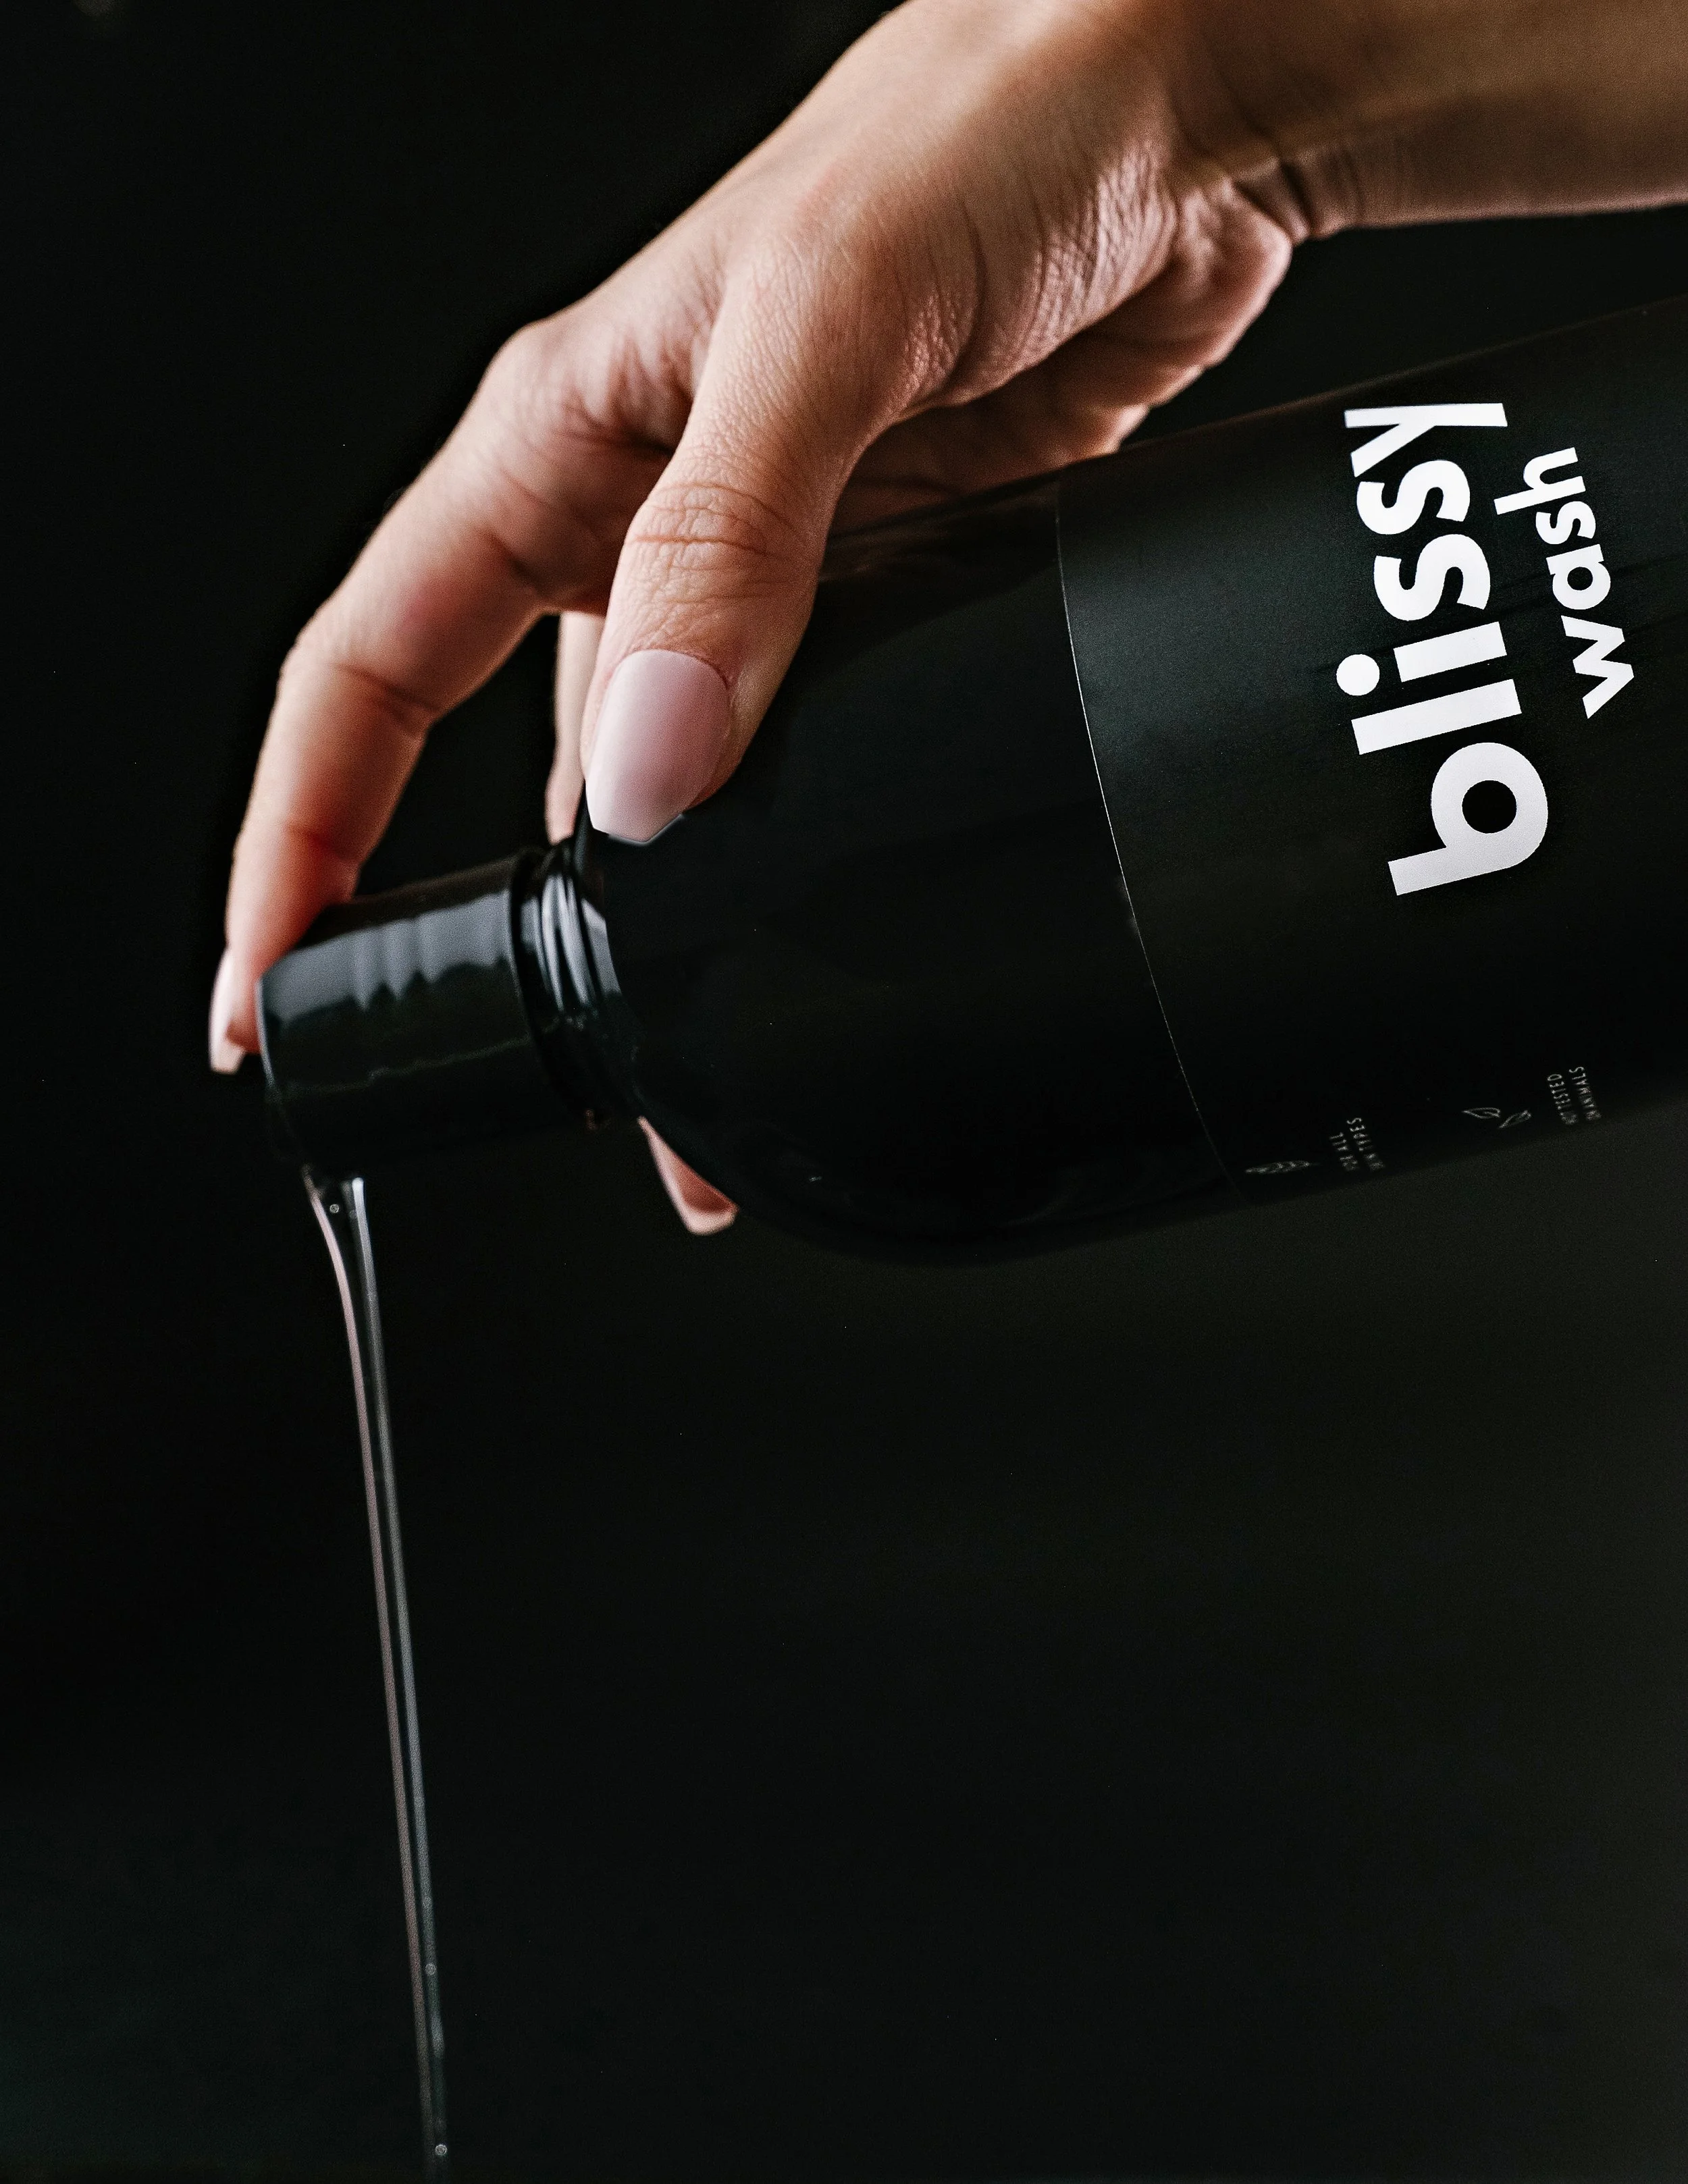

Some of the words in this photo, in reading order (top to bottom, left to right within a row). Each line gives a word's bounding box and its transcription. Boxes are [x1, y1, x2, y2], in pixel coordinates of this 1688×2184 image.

[1336, 402, 1549, 896] blissy
[1494, 446, 1635, 720] wash
[1547, 1073, 1572, 1110] TESTED
